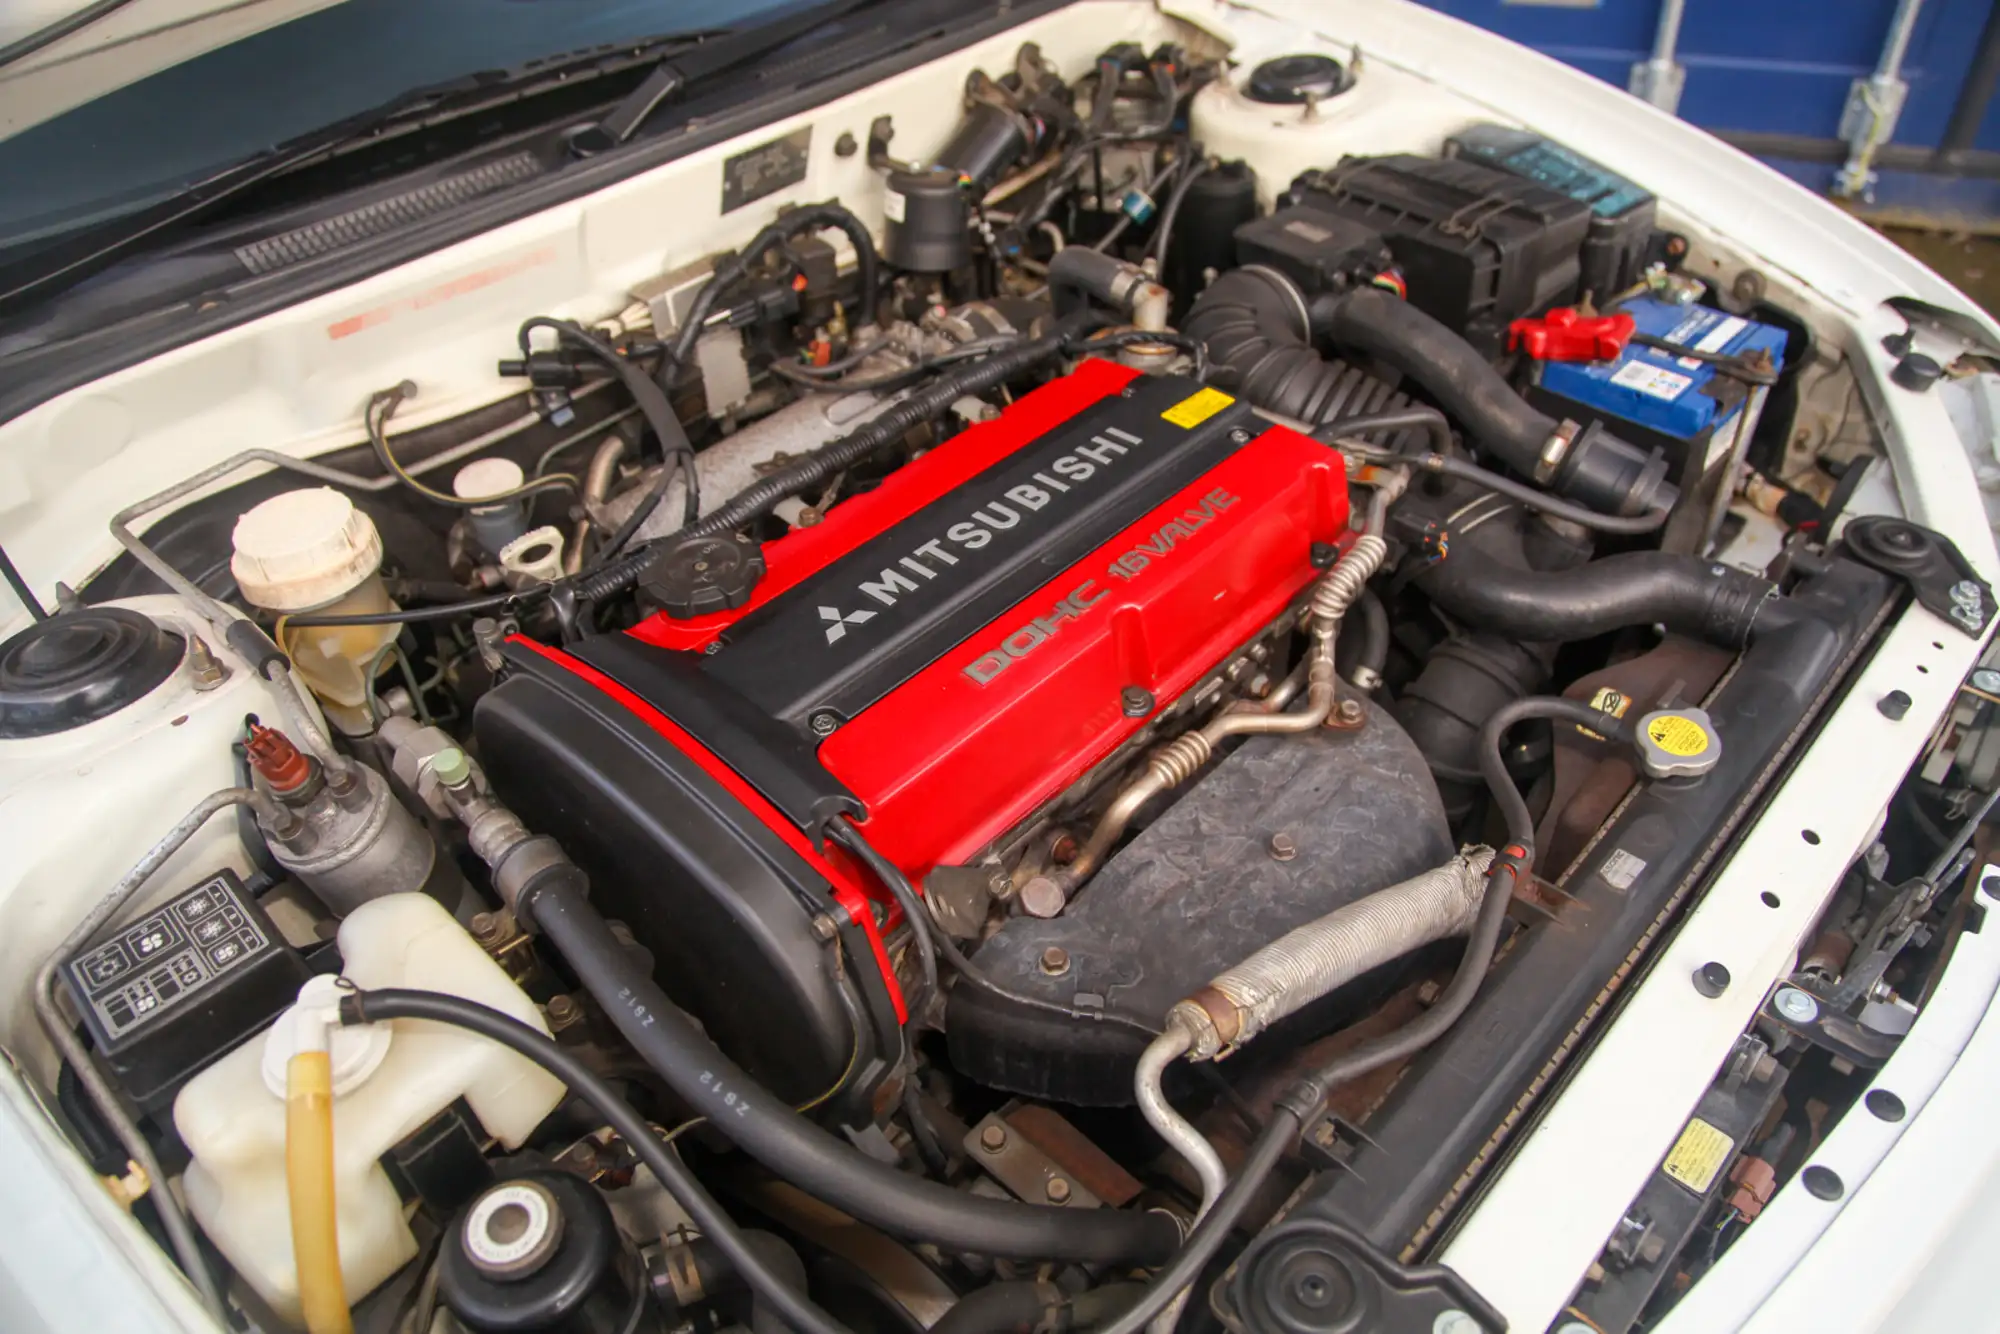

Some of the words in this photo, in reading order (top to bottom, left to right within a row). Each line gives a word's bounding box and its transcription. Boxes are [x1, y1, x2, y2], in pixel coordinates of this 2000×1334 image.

[857, 426, 1143, 606] MITSUBISHI
[960, 579, 1111, 687] DOHC
[1107, 487, 1240, 581] 16VALVE
